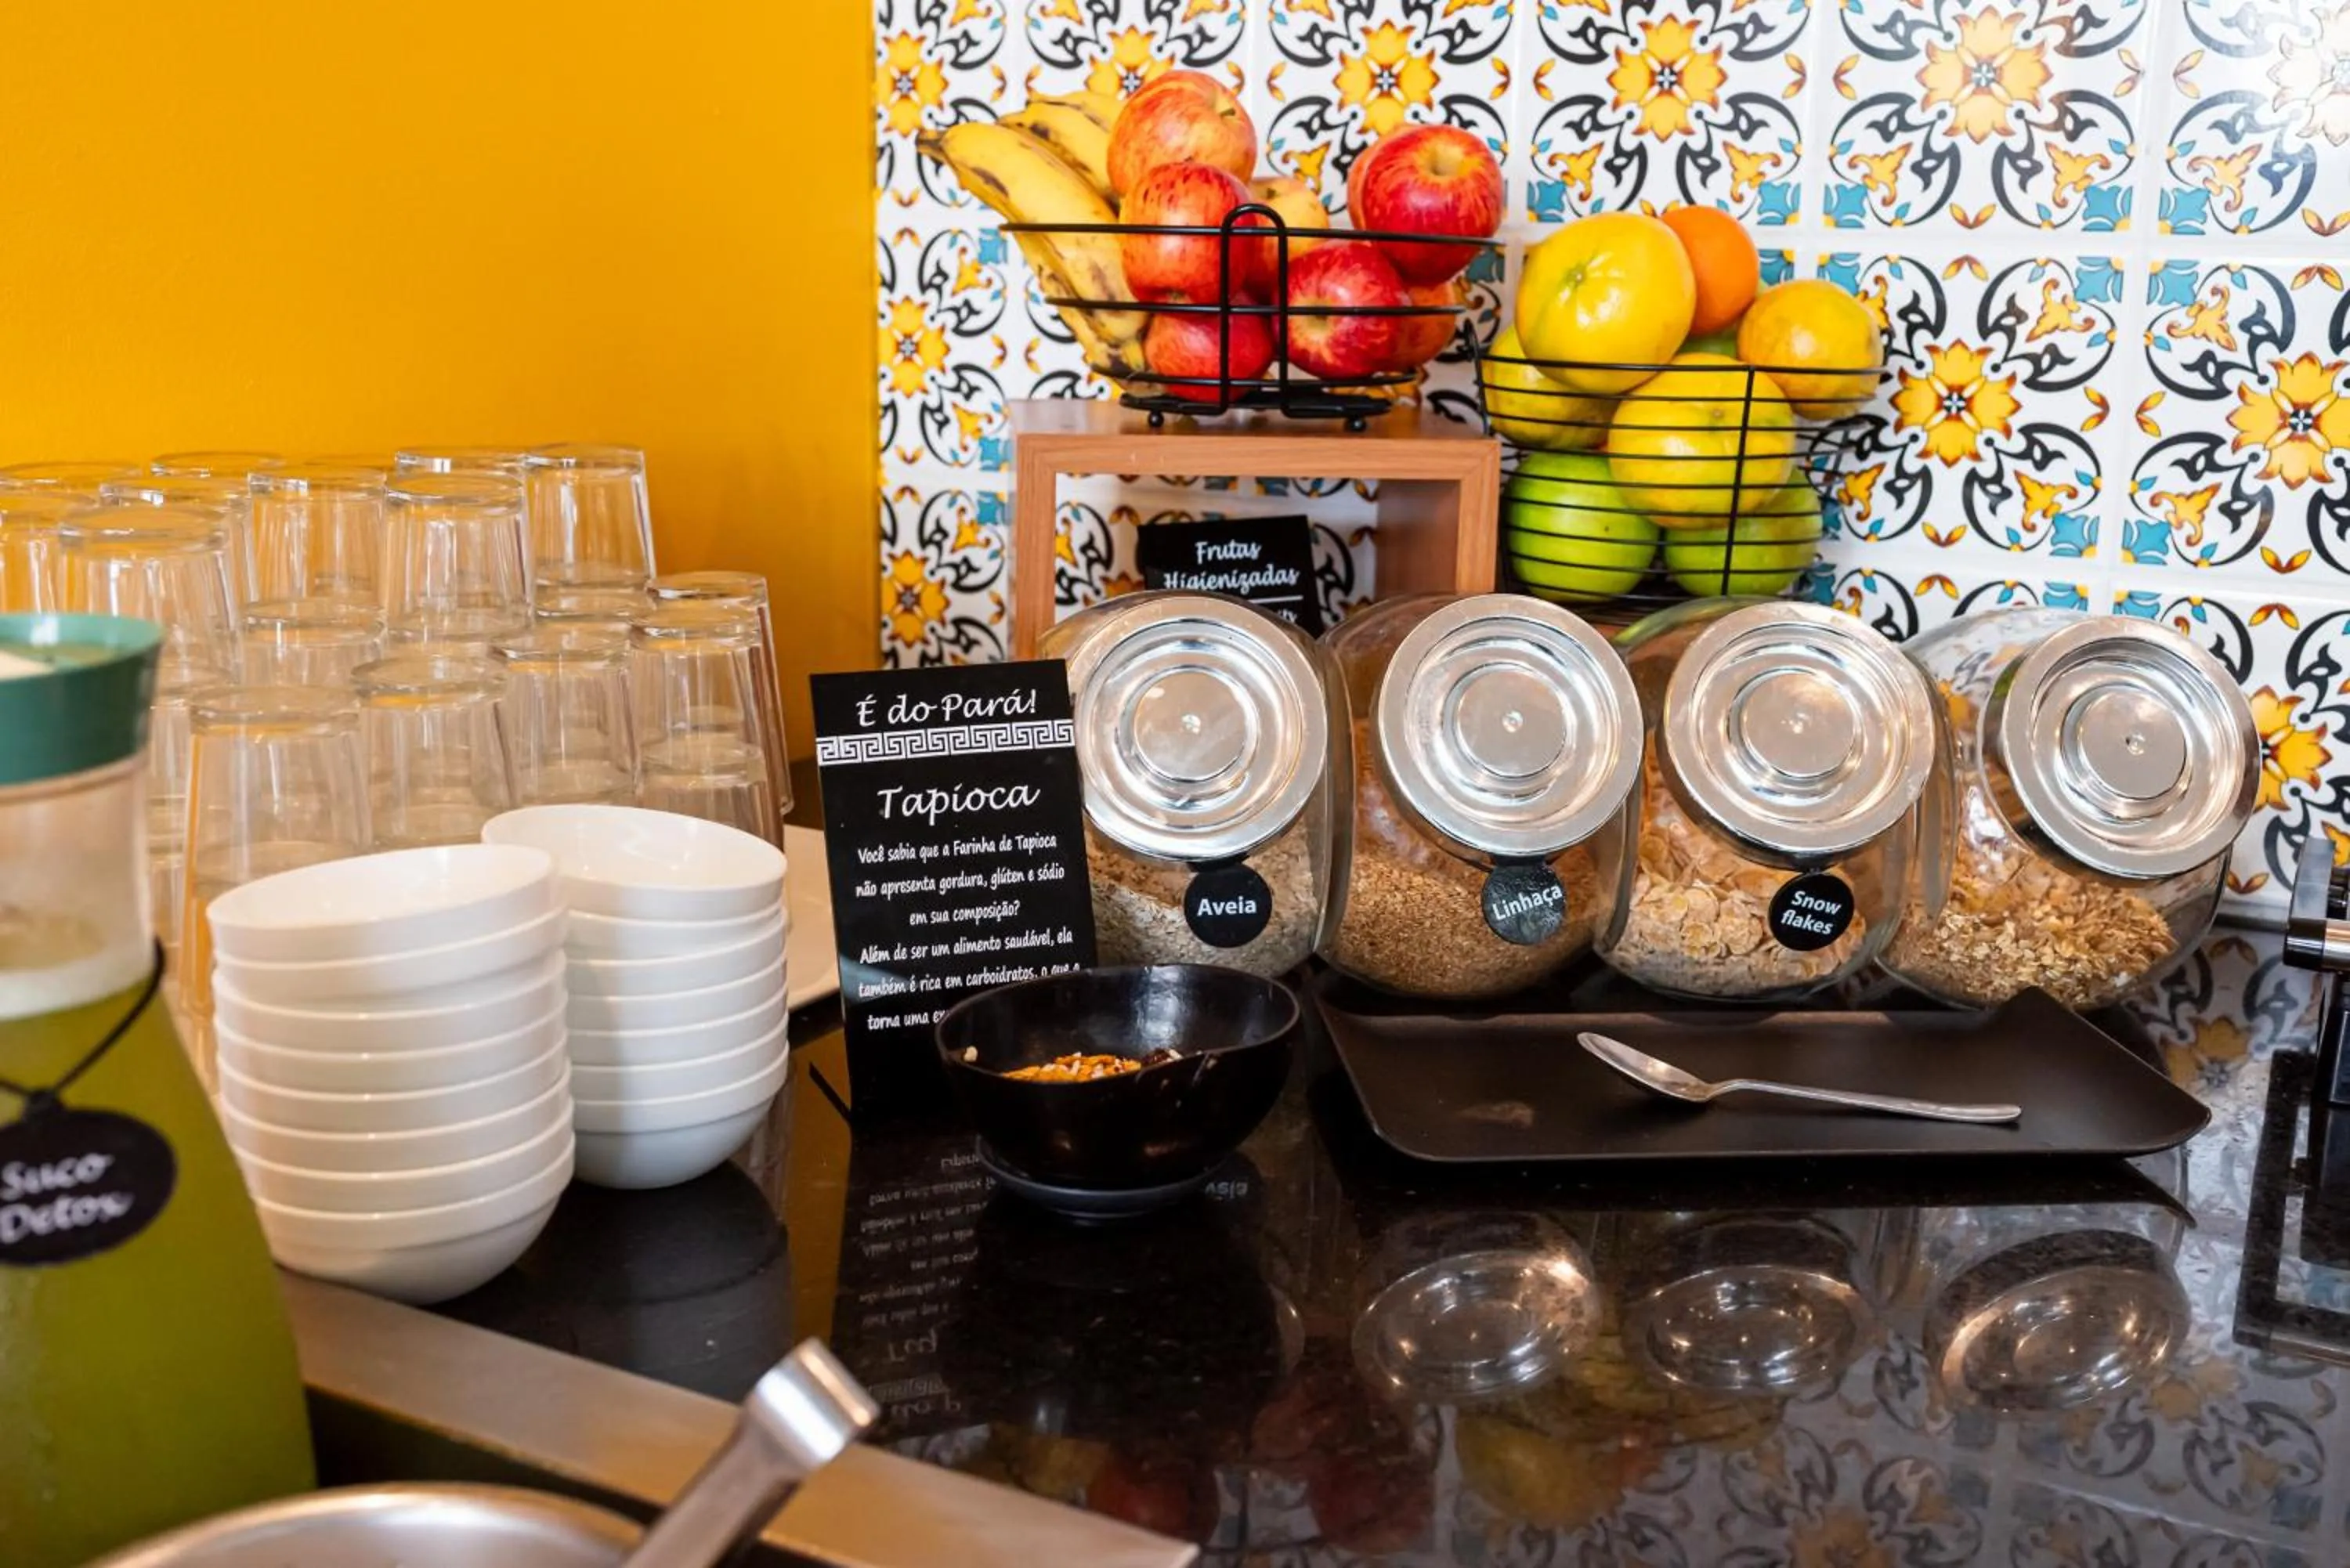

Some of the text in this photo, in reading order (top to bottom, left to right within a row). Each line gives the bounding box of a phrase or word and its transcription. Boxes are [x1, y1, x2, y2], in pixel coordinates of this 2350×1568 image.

[1195, 539, 1262, 565] Frutas
[1163, 564, 1300, 595] Higienizadas
[856, 688, 1036, 727] É do Pará!
[877, 783, 1040, 826] Tapioca
[858, 832, 1057, 864] Você sabia que a Farinha de Tapioca
[855, 862, 1065, 901] não apresenta gordura, glúten e sódio
[909, 899, 1020, 926] em sua composição?
[1196, 898, 1256, 917] Aveia
[1492, 883, 1564, 922] Linhaça
[1791, 891, 1841, 915] Snow
[1781, 909, 1834, 934] flakes
[860, 925, 1073, 964] Além de ser um alimento saudável, ela
[859, 977, 906, 998] também
[909, 974, 916, 993] é
[920, 973, 942, 992] rica
[945, 975, 963, 989] em
[867, 1014, 901, 1030] torna
[903, 1011, 930, 1027] uma
[0, 1153, 115, 1201] Suco
